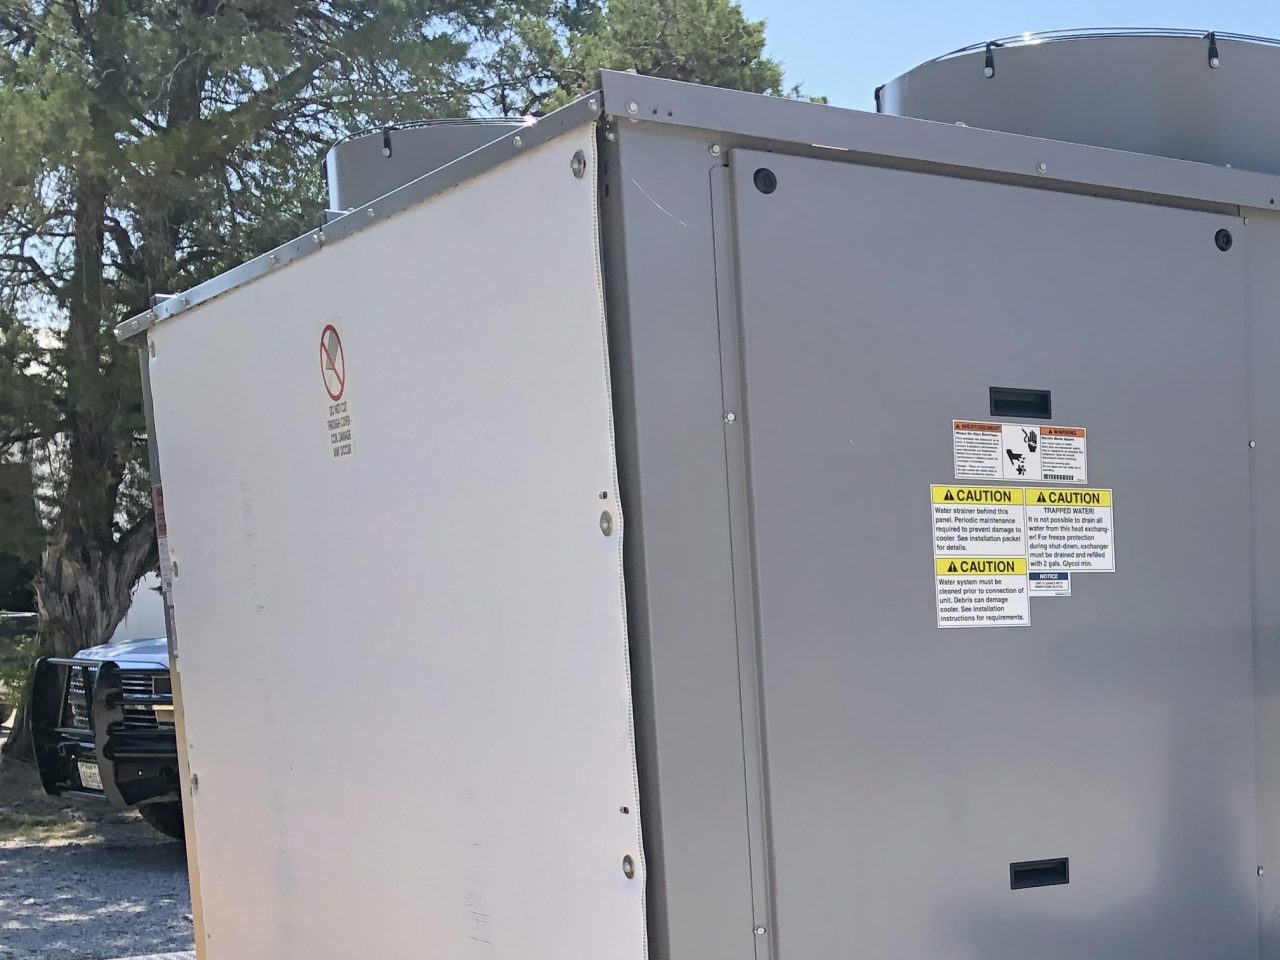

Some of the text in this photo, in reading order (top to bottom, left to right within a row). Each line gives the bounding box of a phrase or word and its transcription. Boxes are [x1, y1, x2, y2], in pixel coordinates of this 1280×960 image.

[957, 490, 1011, 502] CAUTION
[1049, 492, 1100, 504] CAUTION
[960, 561, 1015, 572] CAUTION
